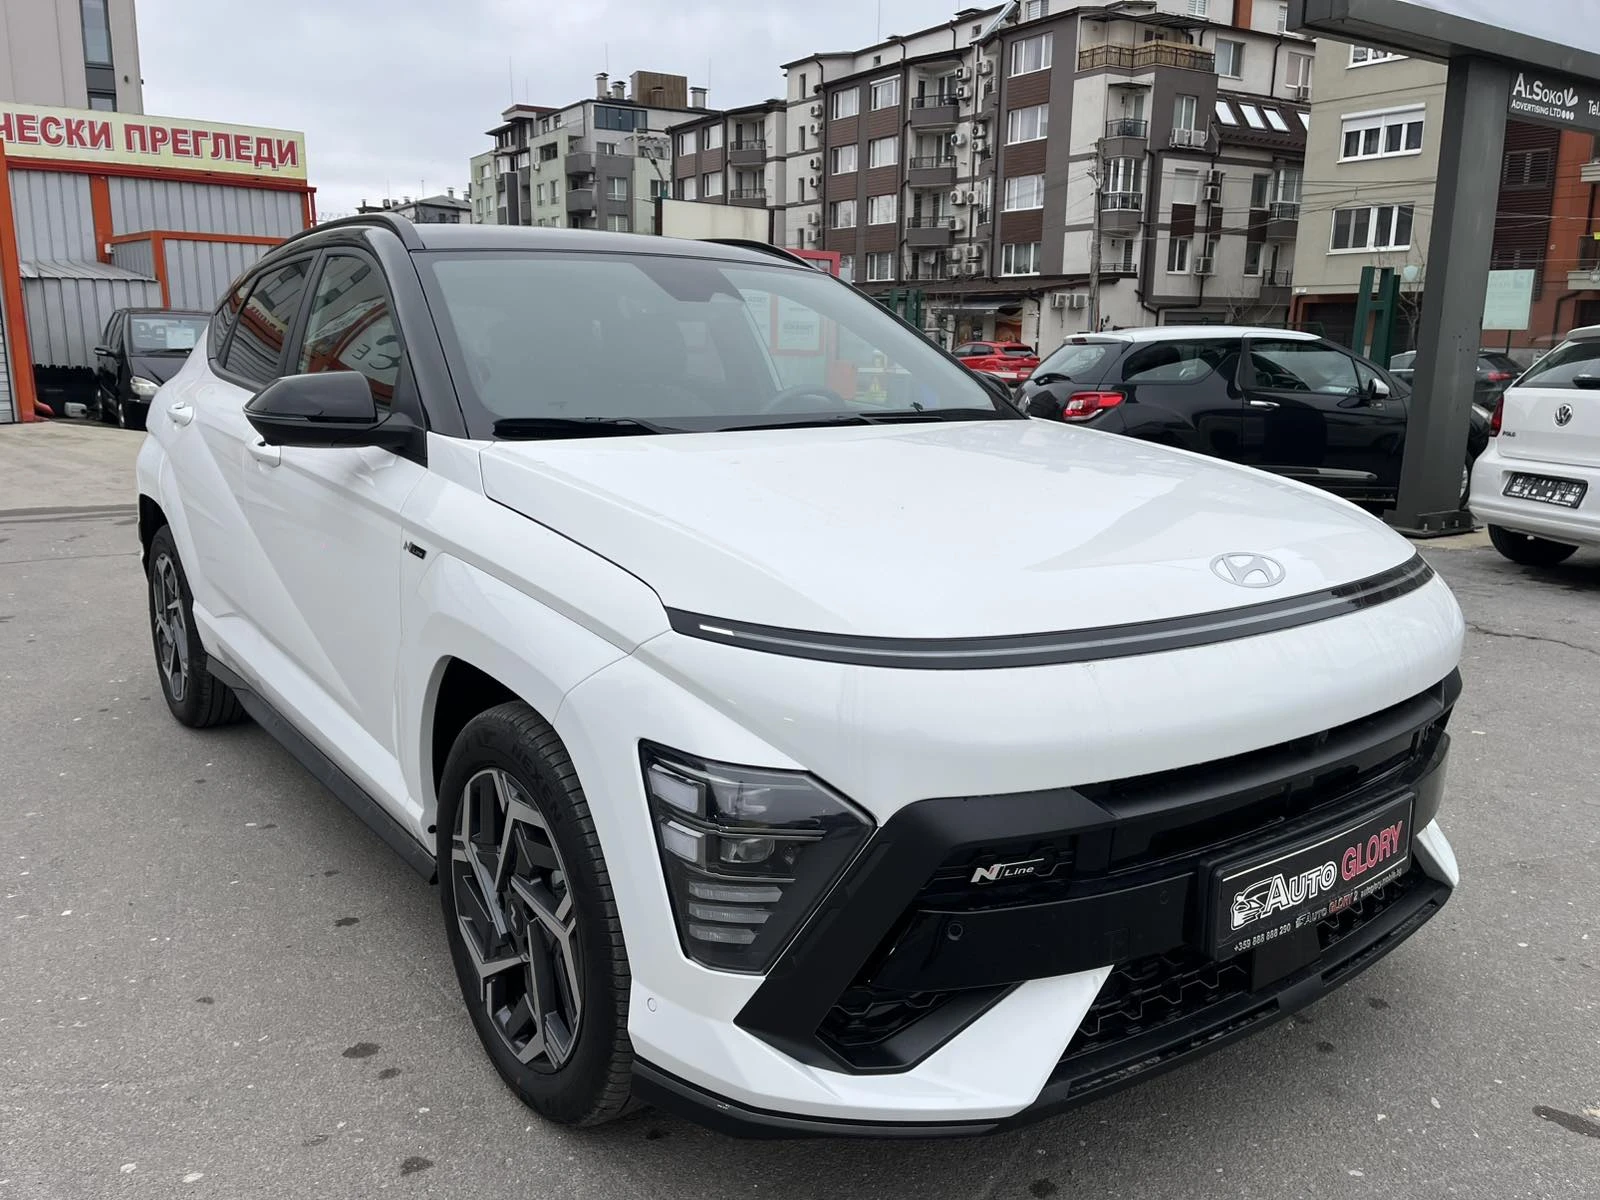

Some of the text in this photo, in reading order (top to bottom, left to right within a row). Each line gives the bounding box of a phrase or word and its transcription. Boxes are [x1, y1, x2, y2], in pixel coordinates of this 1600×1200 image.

[1511, 98, 1549, 115] ADVERTISING
[123, 123, 298, 169] ПРЕГЛЕДИ
[970, 863, 1035, 883] N Line
[1341, 820, 1403, 881] GLORY
[1234, 938, 1251, 951] +359
[1329, 891, 1354, 913] GLORY
